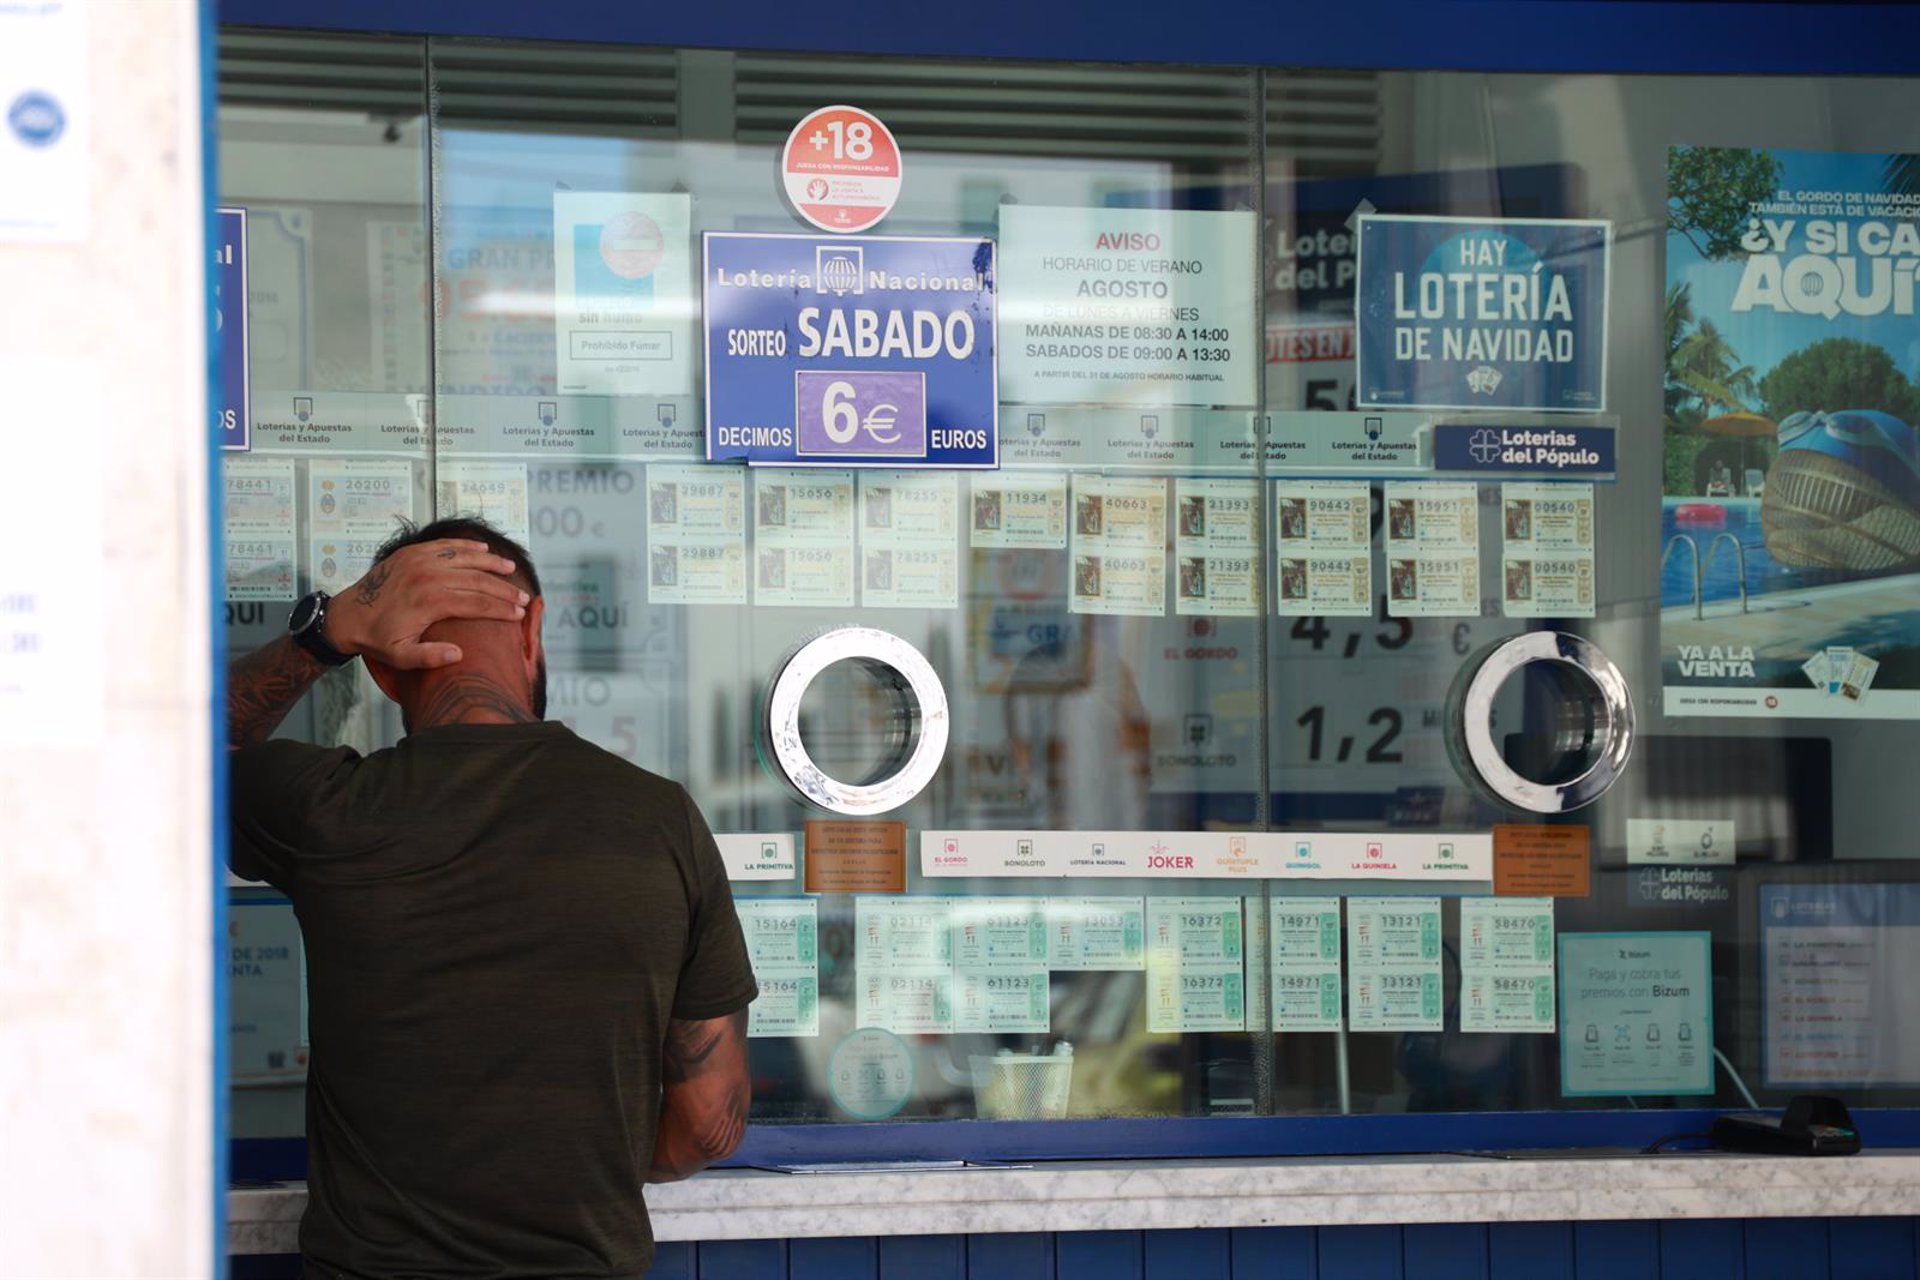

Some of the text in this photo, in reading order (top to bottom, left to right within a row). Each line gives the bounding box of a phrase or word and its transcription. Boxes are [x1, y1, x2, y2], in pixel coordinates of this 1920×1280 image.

[809, 120, 874, 161] +18
[1778, 190, 1792, 200] EL
[1795, 191, 1843, 202] GORDO
[1845, 192, 1862, 203] DE
[1749, 199, 1865, 216] TAMBIÉN ESTÁ DE
[1740, 217, 1797, 252] ¿Y
[1805, 220, 1849, 253] SI
[1096, 232, 1160, 251] AVISO
[1460, 239, 1508, 266] HAY
[1043, 257, 1202, 274] HORARIO DE VERANO
[717, 266, 984, 292] Lotería Nacional
[1275, 260, 1330, 290] del
[1077, 280, 1168, 298] AGOSTO
[1394, 260, 1573, 321] LOTERÍA
[1731, 253, 1920, 321] AQUÍ
[1136, 307, 1200, 321] VIERNES
[728, 306, 975, 360] SORTEO SABADO
[1026, 322, 1229, 341] MAÑANAS DE 08:30 A 14:00
[1395, 327, 1574, 362] DE NAVIDAD
[1026, 344, 1230, 362] SABADOS DE 09:00 A 13:30
[1041, 370, 1068, 378] PARTIR
[1071, 371, 1087, 379] DEL
[1100, 371, 1110, 379] DE
[1112, 372, 1146, 380] AGOSTO
[1147, 372, 1183, 381] HORARIO
[1185, 373, 1224, 382] HABITUAL
[308, 423, 352, 433] Apuestas
[551, 427, 595, 437] Apuestas
[279, 434, 330, 443] del Estado
[403, 436, 417, 445] del
[524, 438, 574, 447] del Estado
[718, 426, 793, 447] DECIMOS
[931, 430, 987, 449] EUROS
[644, 440, 693, 449] del Estado
[1040, 440, 1081, 450] Apuestas
[1153, 440, 1194, 450] Apuestas
[1377, 442, 1417, 452] Apuestas
[1014, 449, 1061, 458] del Estado
[1144, 451, 1174, 459] Estado
[1351, 452, 1398, 461] del Estado
[1502, 447, 1600, 467] del Pópulo
[345, 479, 390, 490] 26200
[1310, 500, 1351, 512] 90442
[1535, 502, 1575, 513] 00540
[1209, 561, 1250, 572] 21393
[1535, 562, 1575, 574] 00540
[1453, 623, 1471, 655] €
[1163, 647, 1238, 660] EL GORDO
[1678, 645, 1755, 661] YA A LA
[1679, 661, 1756, 678] VENTA
[1296, 705, 1404, 764] 1,2
[756, 863, 794, 871] PRIMITIVA
[1004, 859, 1046, 868] BONOLOTO
[1096, 859, 1127, 867] NACIONAL
[1147, 856, 1194, 870] JOKER
[1351, 862, 1397, 870] LA QUINIELA
[1434, 863, 1469, 871] PRIMITIVA
[1661, 885, 1683, 900] del
[755, 918, 796, 929] 15164
[1181, 916, 1222, 927] 16372
[1280, 916, 1320, 928] 14971
[1381, 916, 1421, 928] 13121
[1494, 918, 1535, 929] 58470
[1589, 967, 1681, 983] Paga y cobra tus
[1182, 977, 1223, 988] 16372
[1280, 977, 1320, 989] 14971
[1494, 979, 1535, 990] 58470
[1581, 985, 1690, 1000] premios con Bizum
